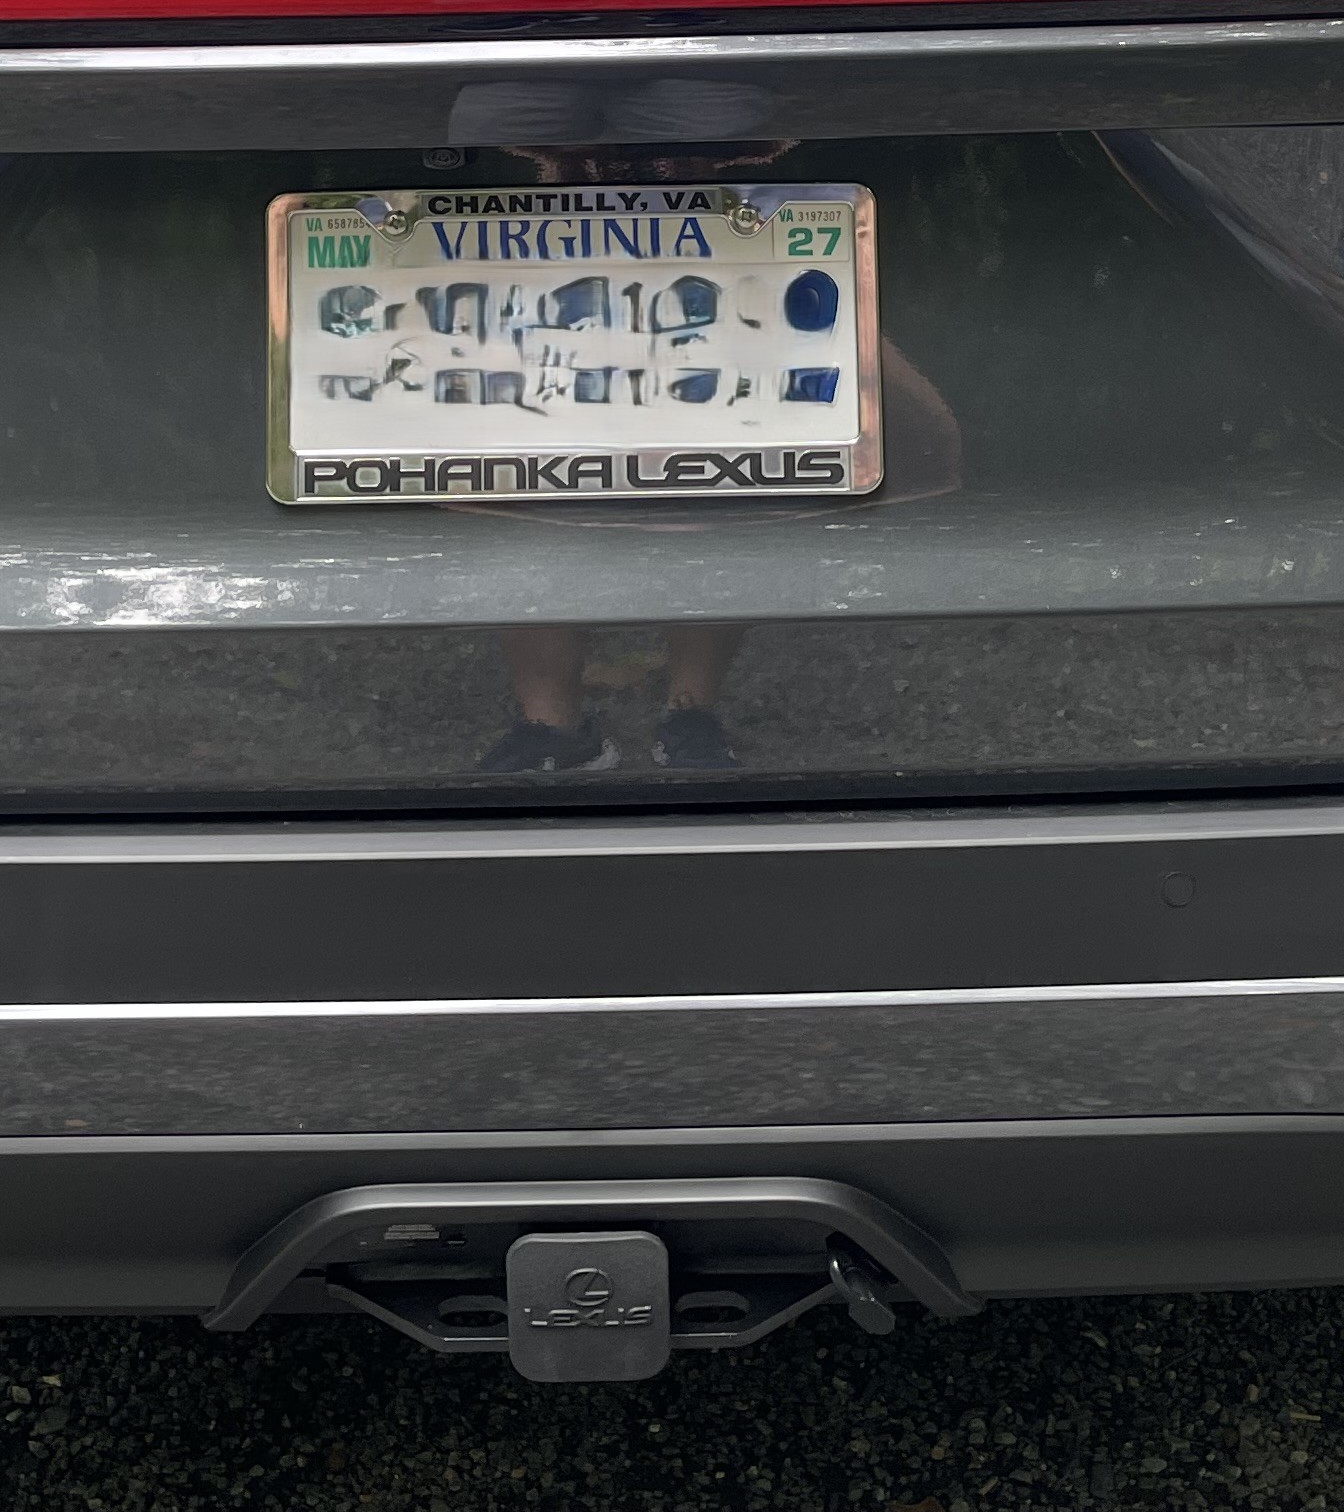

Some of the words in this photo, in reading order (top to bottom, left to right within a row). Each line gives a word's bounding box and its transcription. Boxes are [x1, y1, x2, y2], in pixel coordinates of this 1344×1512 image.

[427, 191, 649, 215] CHANTILLY,
[662, 191, 712, 211] VA
[778, 208, 794, 222] VA
[798, 210, 842, 222] 3197307
[306, 217, 323, 232] VA
[430, 216, 713, 260] VIRGINIA
[308, 234, 372, 269] MAY
[787, 227, 842, 256] 27
[303, 454, 613, 493] POHANKA
[626, 450, 845, 487] LEXUS
